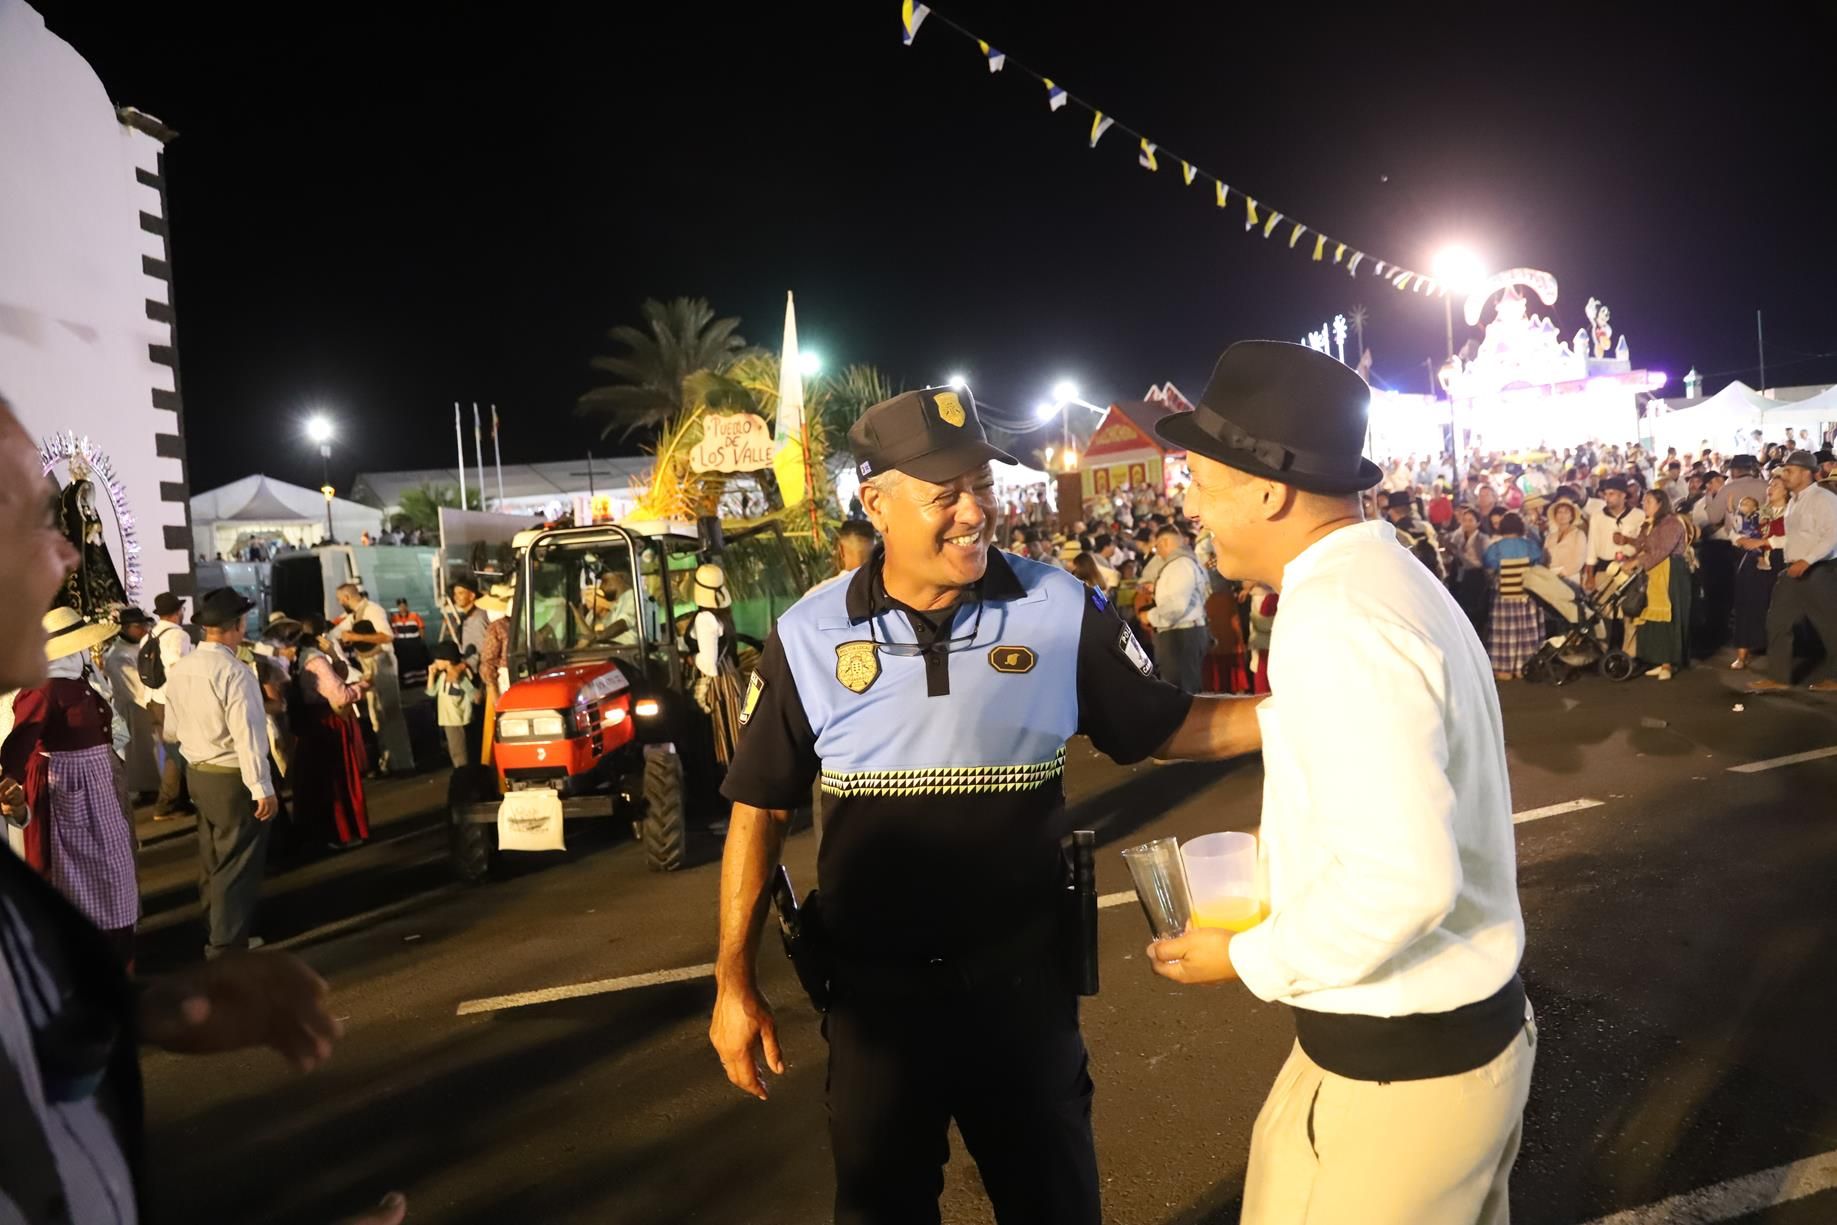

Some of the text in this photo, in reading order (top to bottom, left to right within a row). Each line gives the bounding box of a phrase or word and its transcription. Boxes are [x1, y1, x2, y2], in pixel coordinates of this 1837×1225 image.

[725, 435, 741, 447] DE
[701, 441, 775, 467] LOS VALLE
